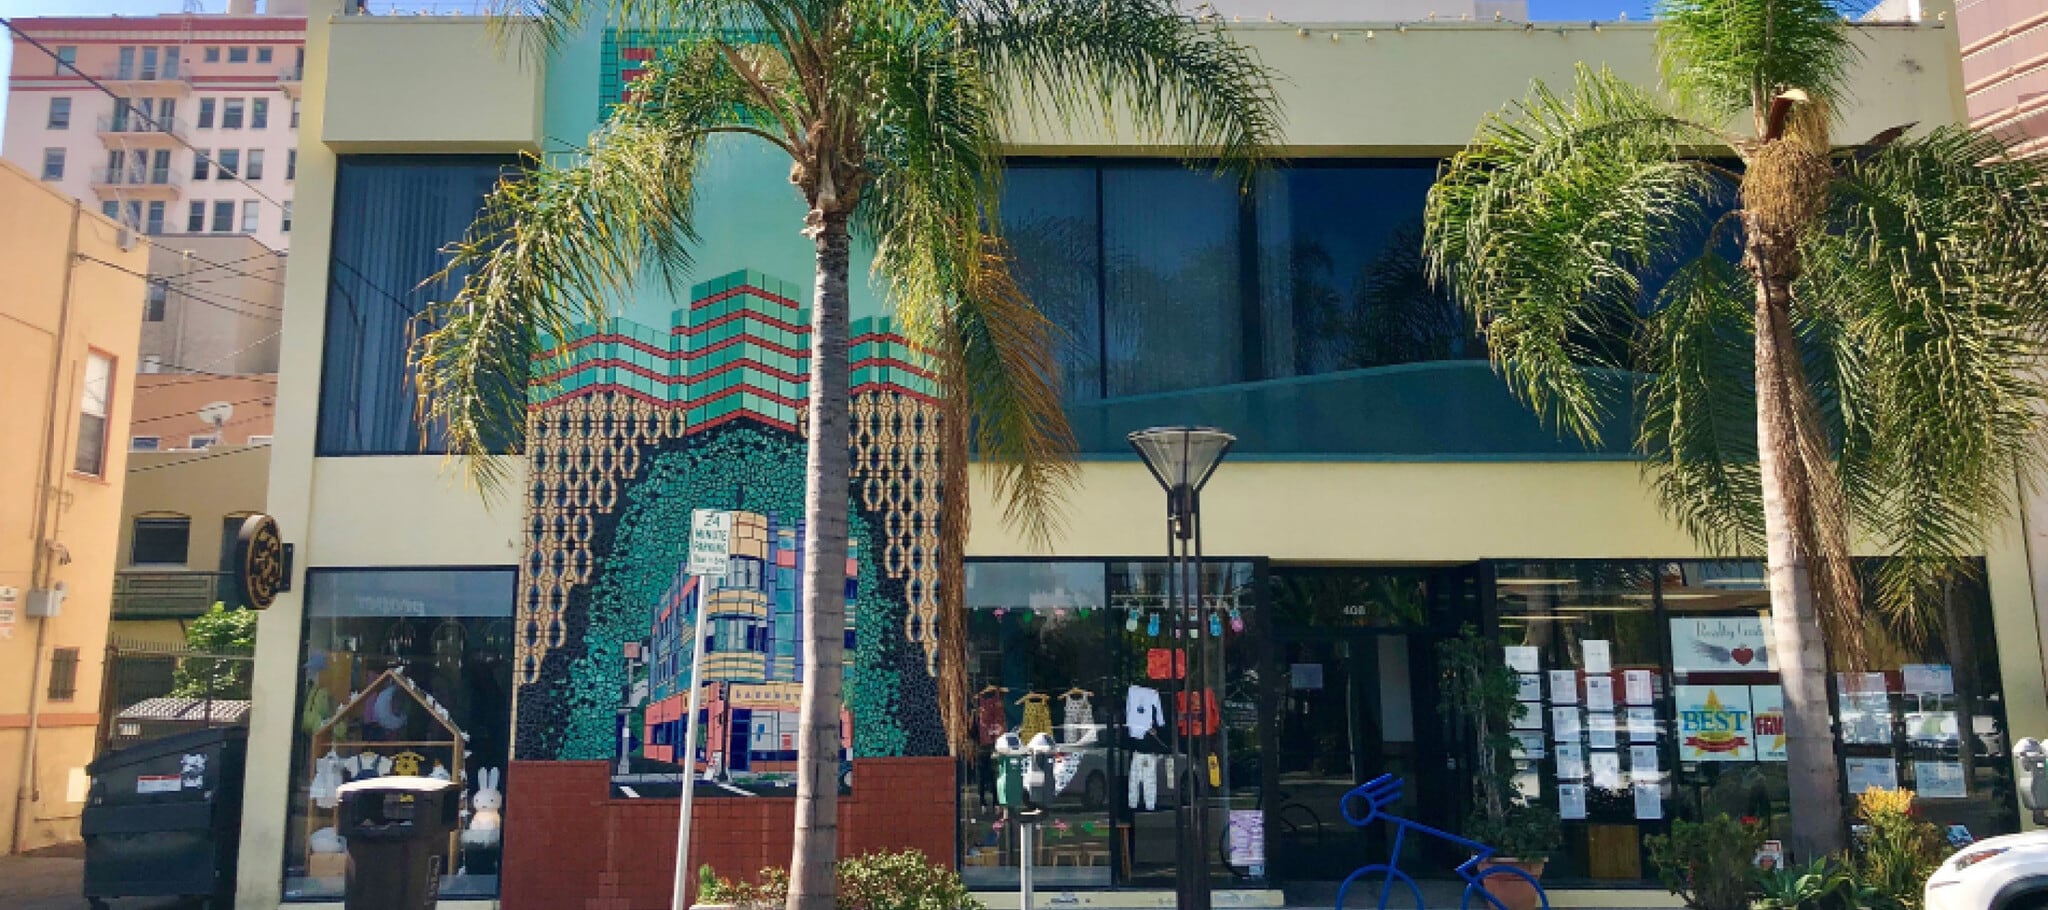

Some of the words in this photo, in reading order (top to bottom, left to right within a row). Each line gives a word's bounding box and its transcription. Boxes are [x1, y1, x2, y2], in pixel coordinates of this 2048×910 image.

[703, 511, 720, 528] 24
[695, 528, 727, 541] MINUTE
[1680, 710, 1748, 731] BEST
